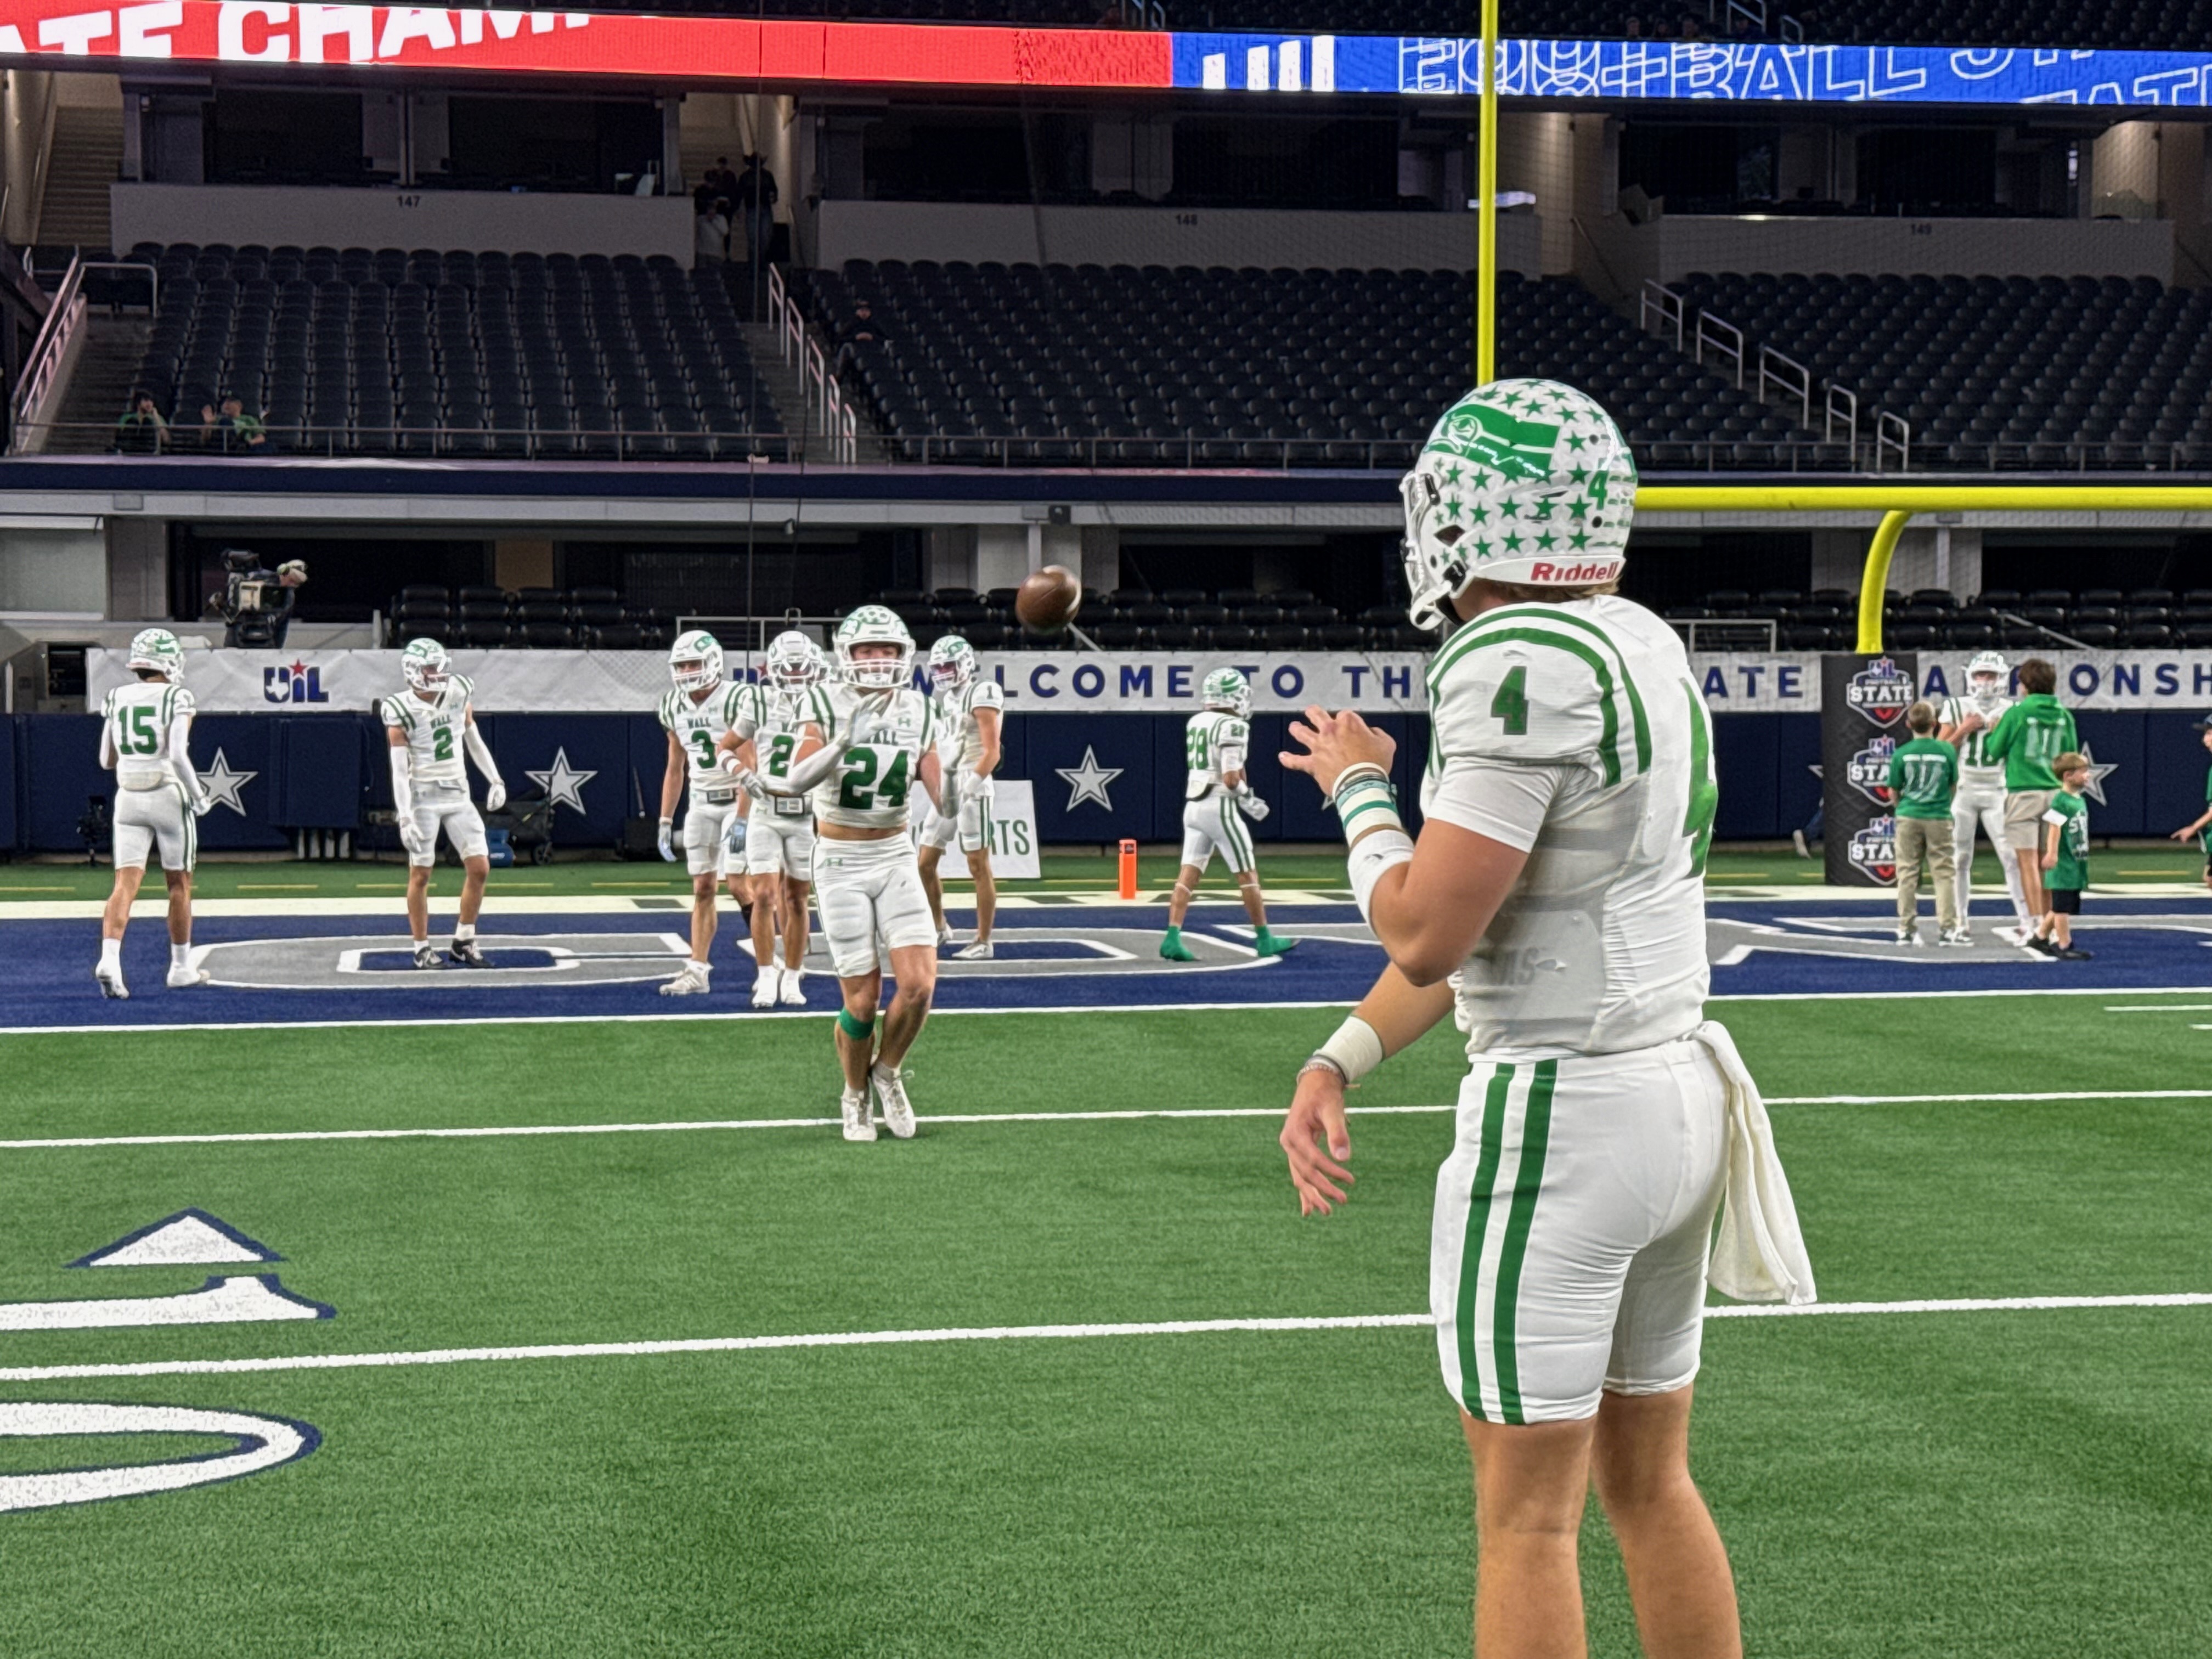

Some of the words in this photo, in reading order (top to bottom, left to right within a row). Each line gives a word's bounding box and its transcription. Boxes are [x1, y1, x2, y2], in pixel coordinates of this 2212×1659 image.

[218, 1, 590, 62] CHAM
[397, 195, 421, 208] 147
[1531, 561, 1619, 582] Riddell
[1231, 665, 1304, 698] TO
[1342, 665, 1429, 698] TH
[1850, 686, 1912, 702] STATE
[1491, 666, 1530, 735] 4
[118, 706, 158, 754] 15
[687, 717, 712, 729] WALL
[433, 726, 454, 761] 2
[691, 730, 717, 769] 3
[1187, 726, 1208, 769] 28
[839, 747, 910, 810] 24
[1850, 764, 1890, 781] STA
[1852, 844, 1894, 860] STA
